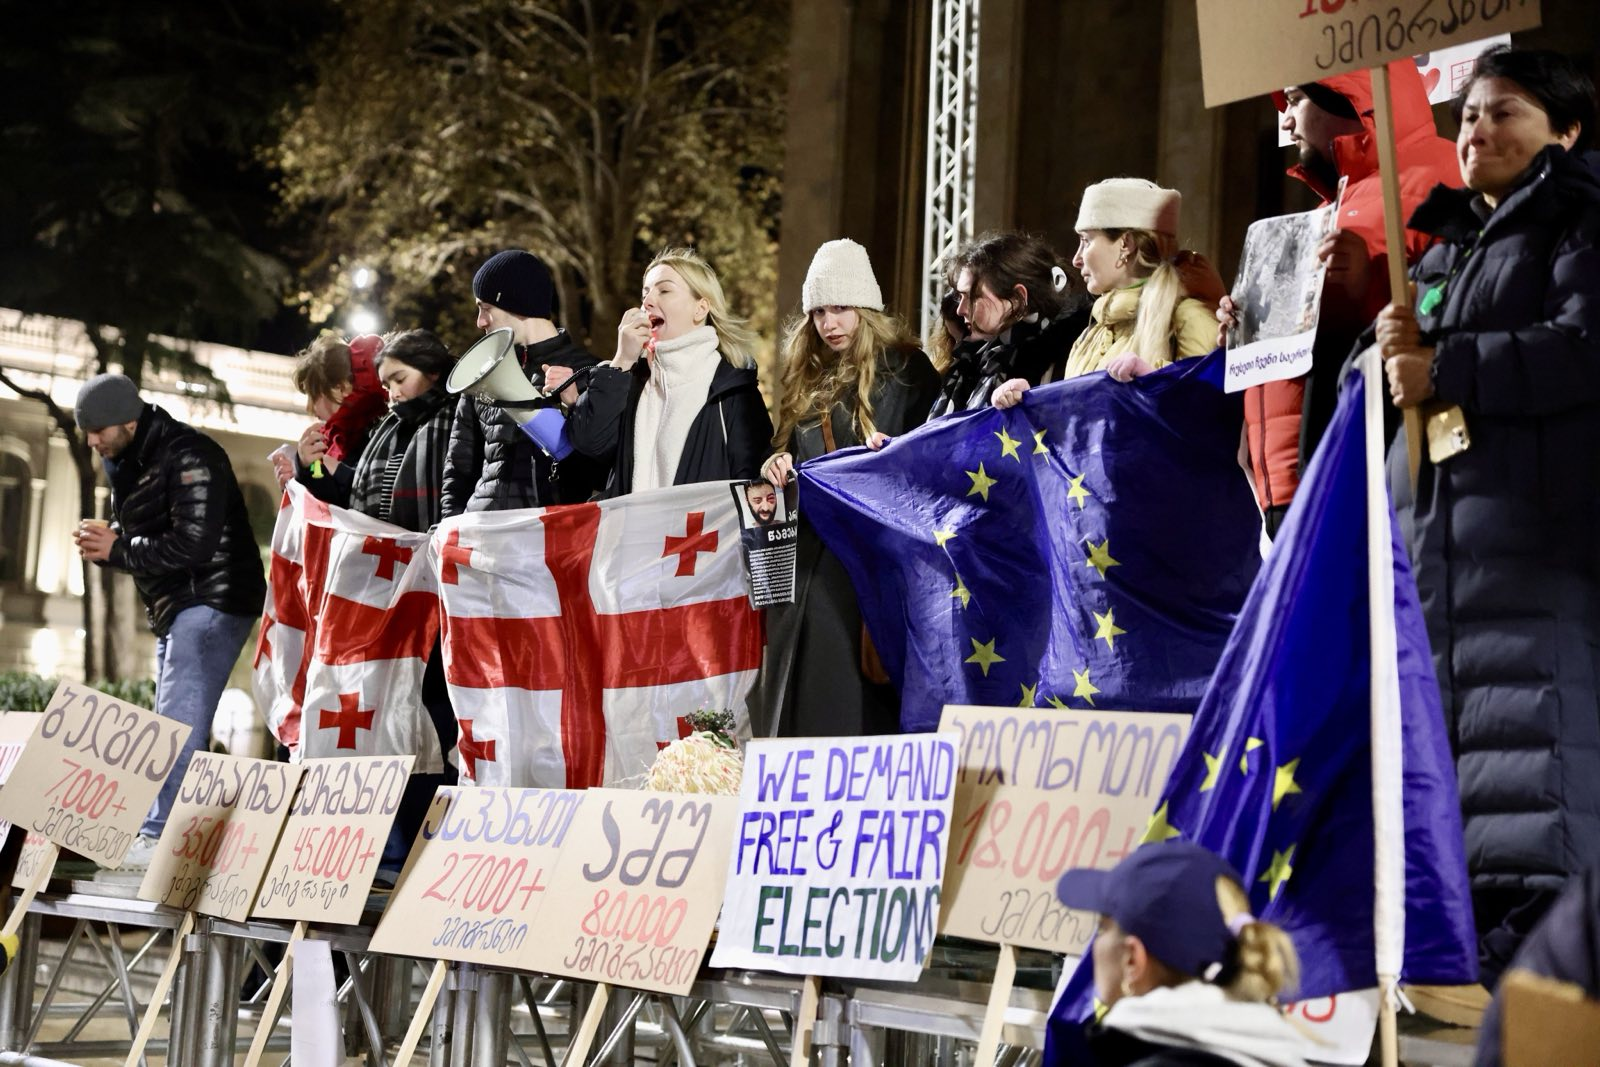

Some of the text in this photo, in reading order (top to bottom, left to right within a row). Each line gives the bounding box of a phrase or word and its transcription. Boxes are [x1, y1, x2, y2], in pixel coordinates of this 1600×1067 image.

[41, 686, 181, 782] ბელგია
[44, 758, 127, 820] 7,000+
[181, 757, 287, 814] უკრაინა
[757, 740, 954, 802] WE DEMAND
[32, 806, 132, 860] ემიგრანტი
[171, 816, 259, 874] 35,000+
[292, 825, 376, 881] 45,000+
[582, 798, 712, 888] აშშ
[736, 809, 946, 880] FREE & FAIR
[161, 863, 249, 918] ემიგრანტი
[261, 864, 349, 910] ემიგრანტი
[421, 852, 546, 915] 27,000+
[432, 917, 529, 954] ემიგრანტი
[581, 889, 688, 947] 80,000
[563, 936, 699, 986] ემიგრანტი
